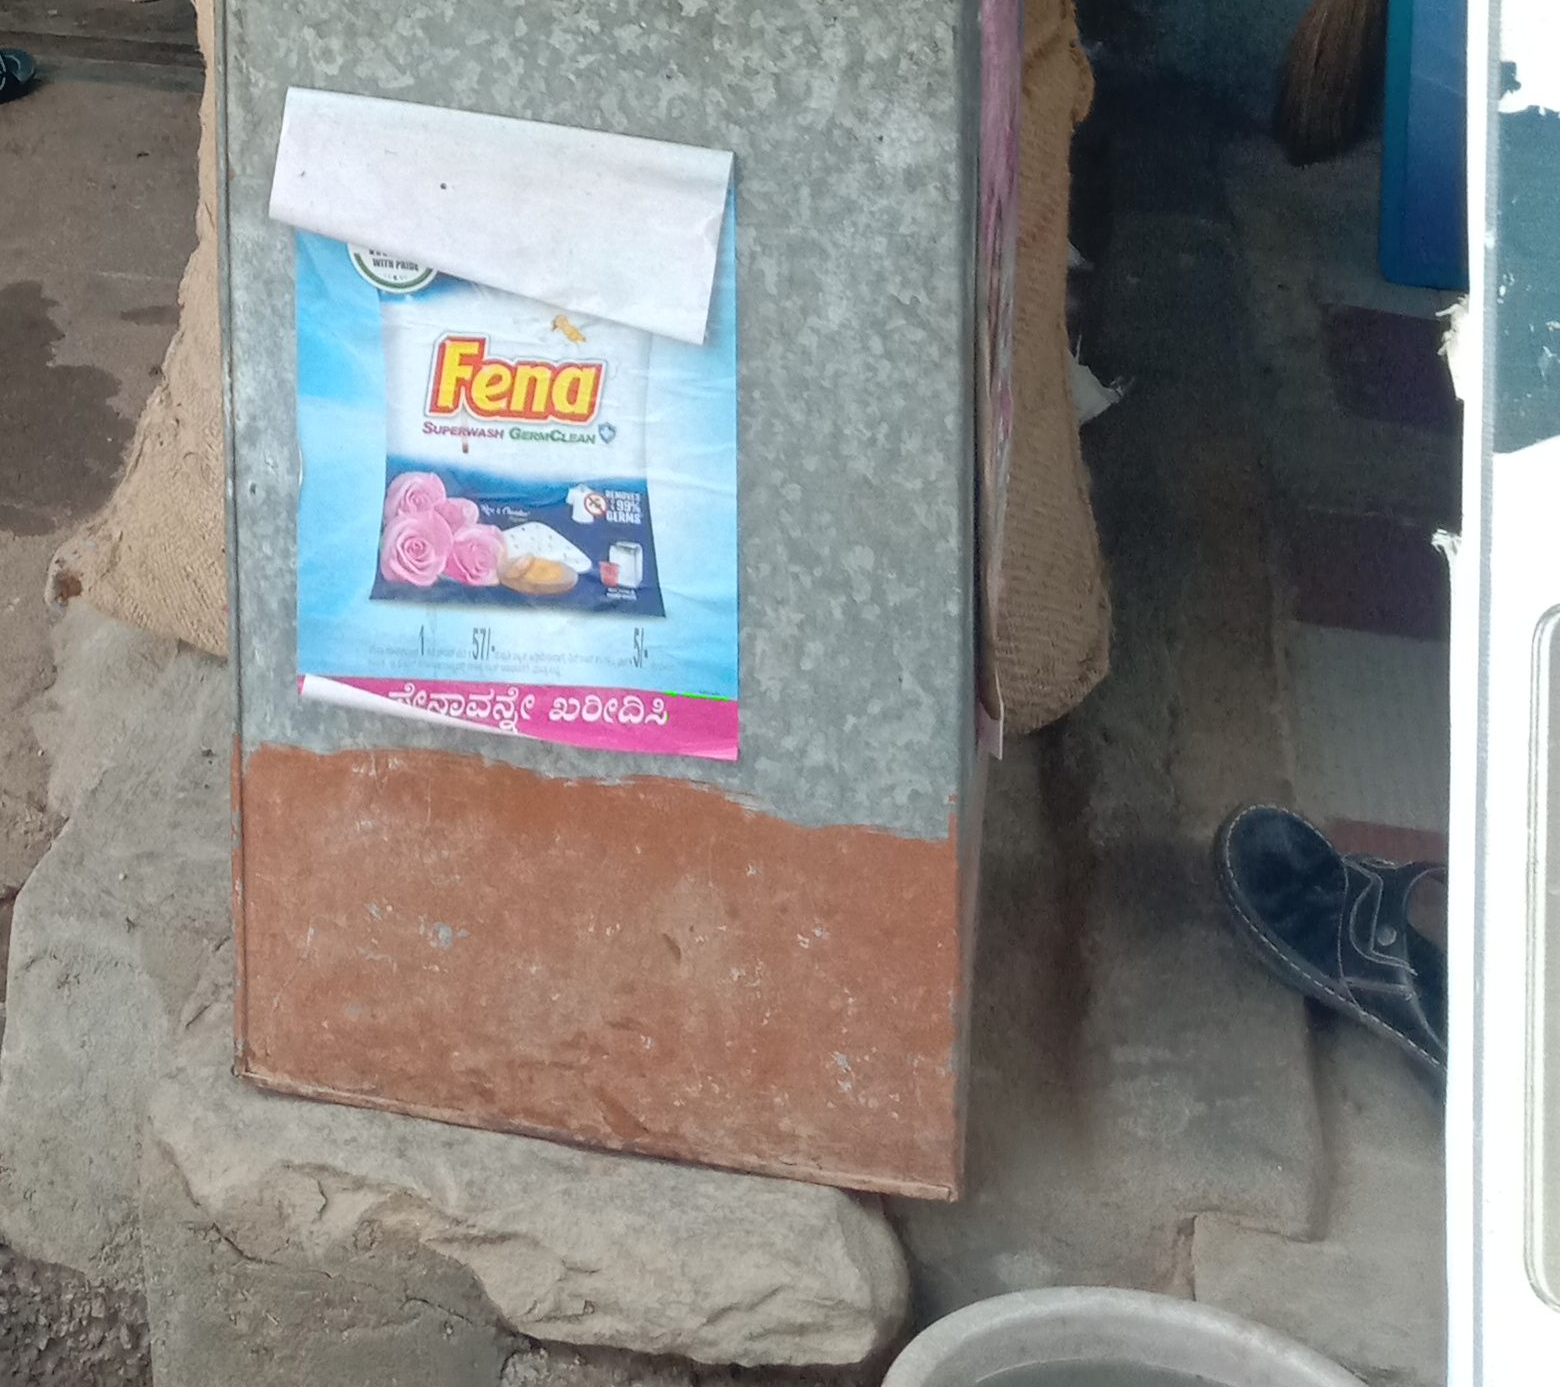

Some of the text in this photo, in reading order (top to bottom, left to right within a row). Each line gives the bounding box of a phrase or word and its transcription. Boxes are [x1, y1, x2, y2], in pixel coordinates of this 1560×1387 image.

[428, 335, 604, 423] Fena
[605, 510, 642, 525] GERMS
[418, 624, 425, 656] 1
[472, 626, 497, 662] 57/-
[548, 688, 670, 727] ಖರೀದಿಸಿ
